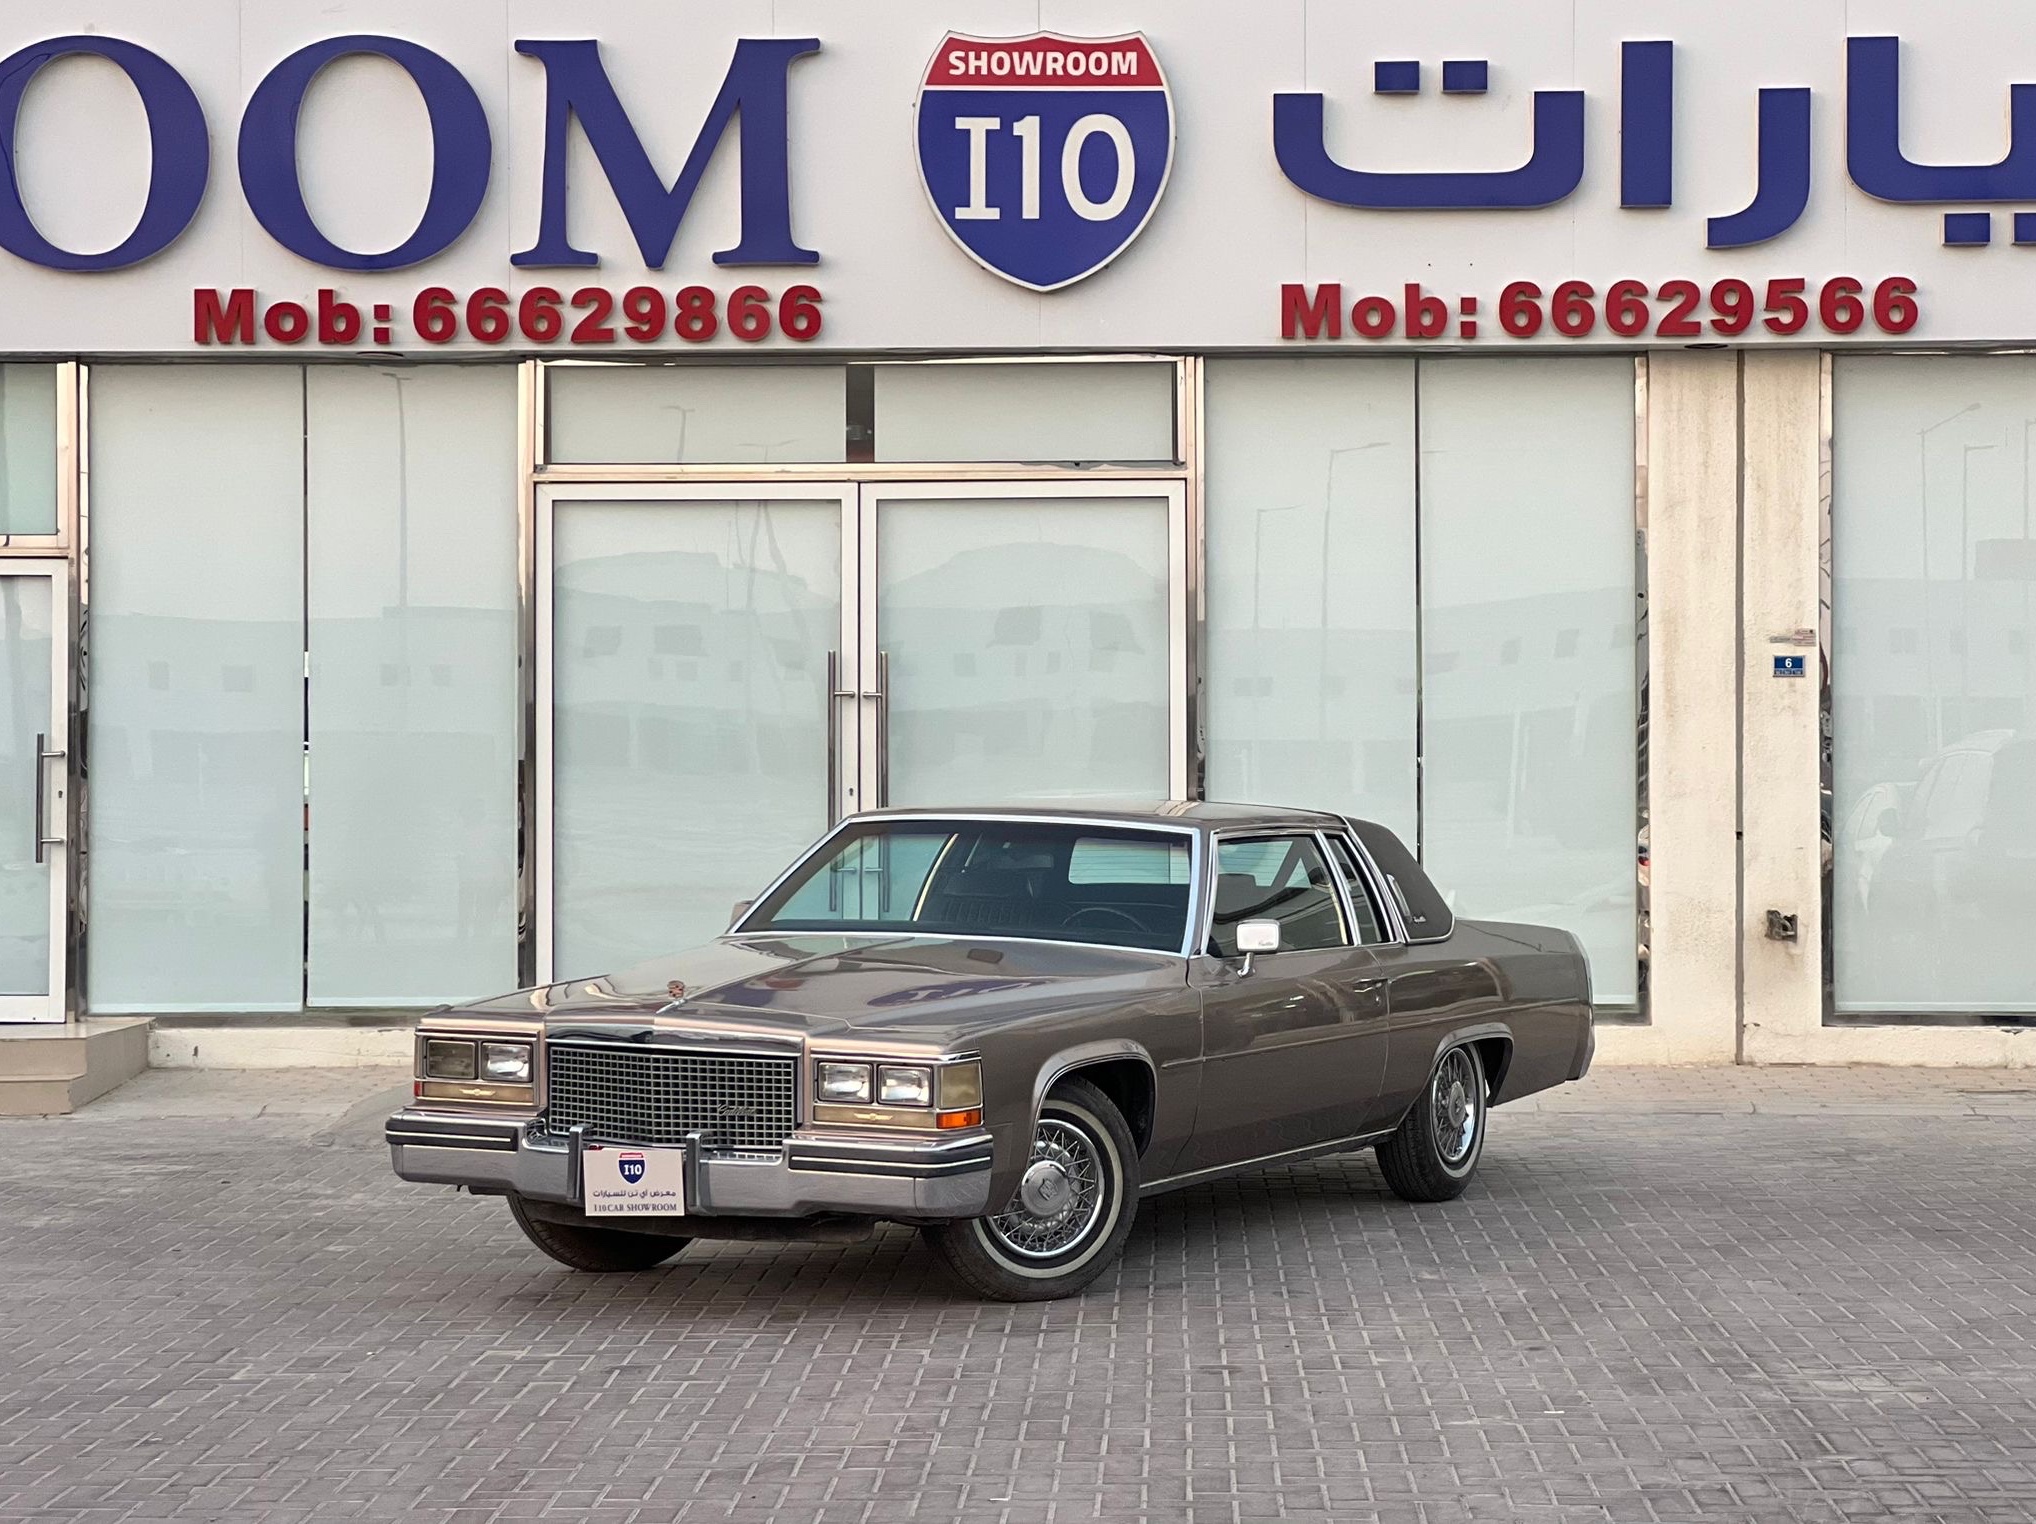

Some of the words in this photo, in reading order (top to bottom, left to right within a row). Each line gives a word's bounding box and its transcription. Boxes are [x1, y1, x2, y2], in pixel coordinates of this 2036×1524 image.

[948, 50, 1138, 76] SHOWROOM
[954, 113, 1136, 221] I10
[193, 288, 392, 344] Mob:
[413, 285, 823, 343] 66629866
[1281, 283, 1477, 338] Mob:
[1498, 277, 1919, 337] 66629566
[1785, 658, 1793, 668] 6
[623, 1164, 642, 1175] I10
[626, 1203, 677, 1212] SHOWROOM
